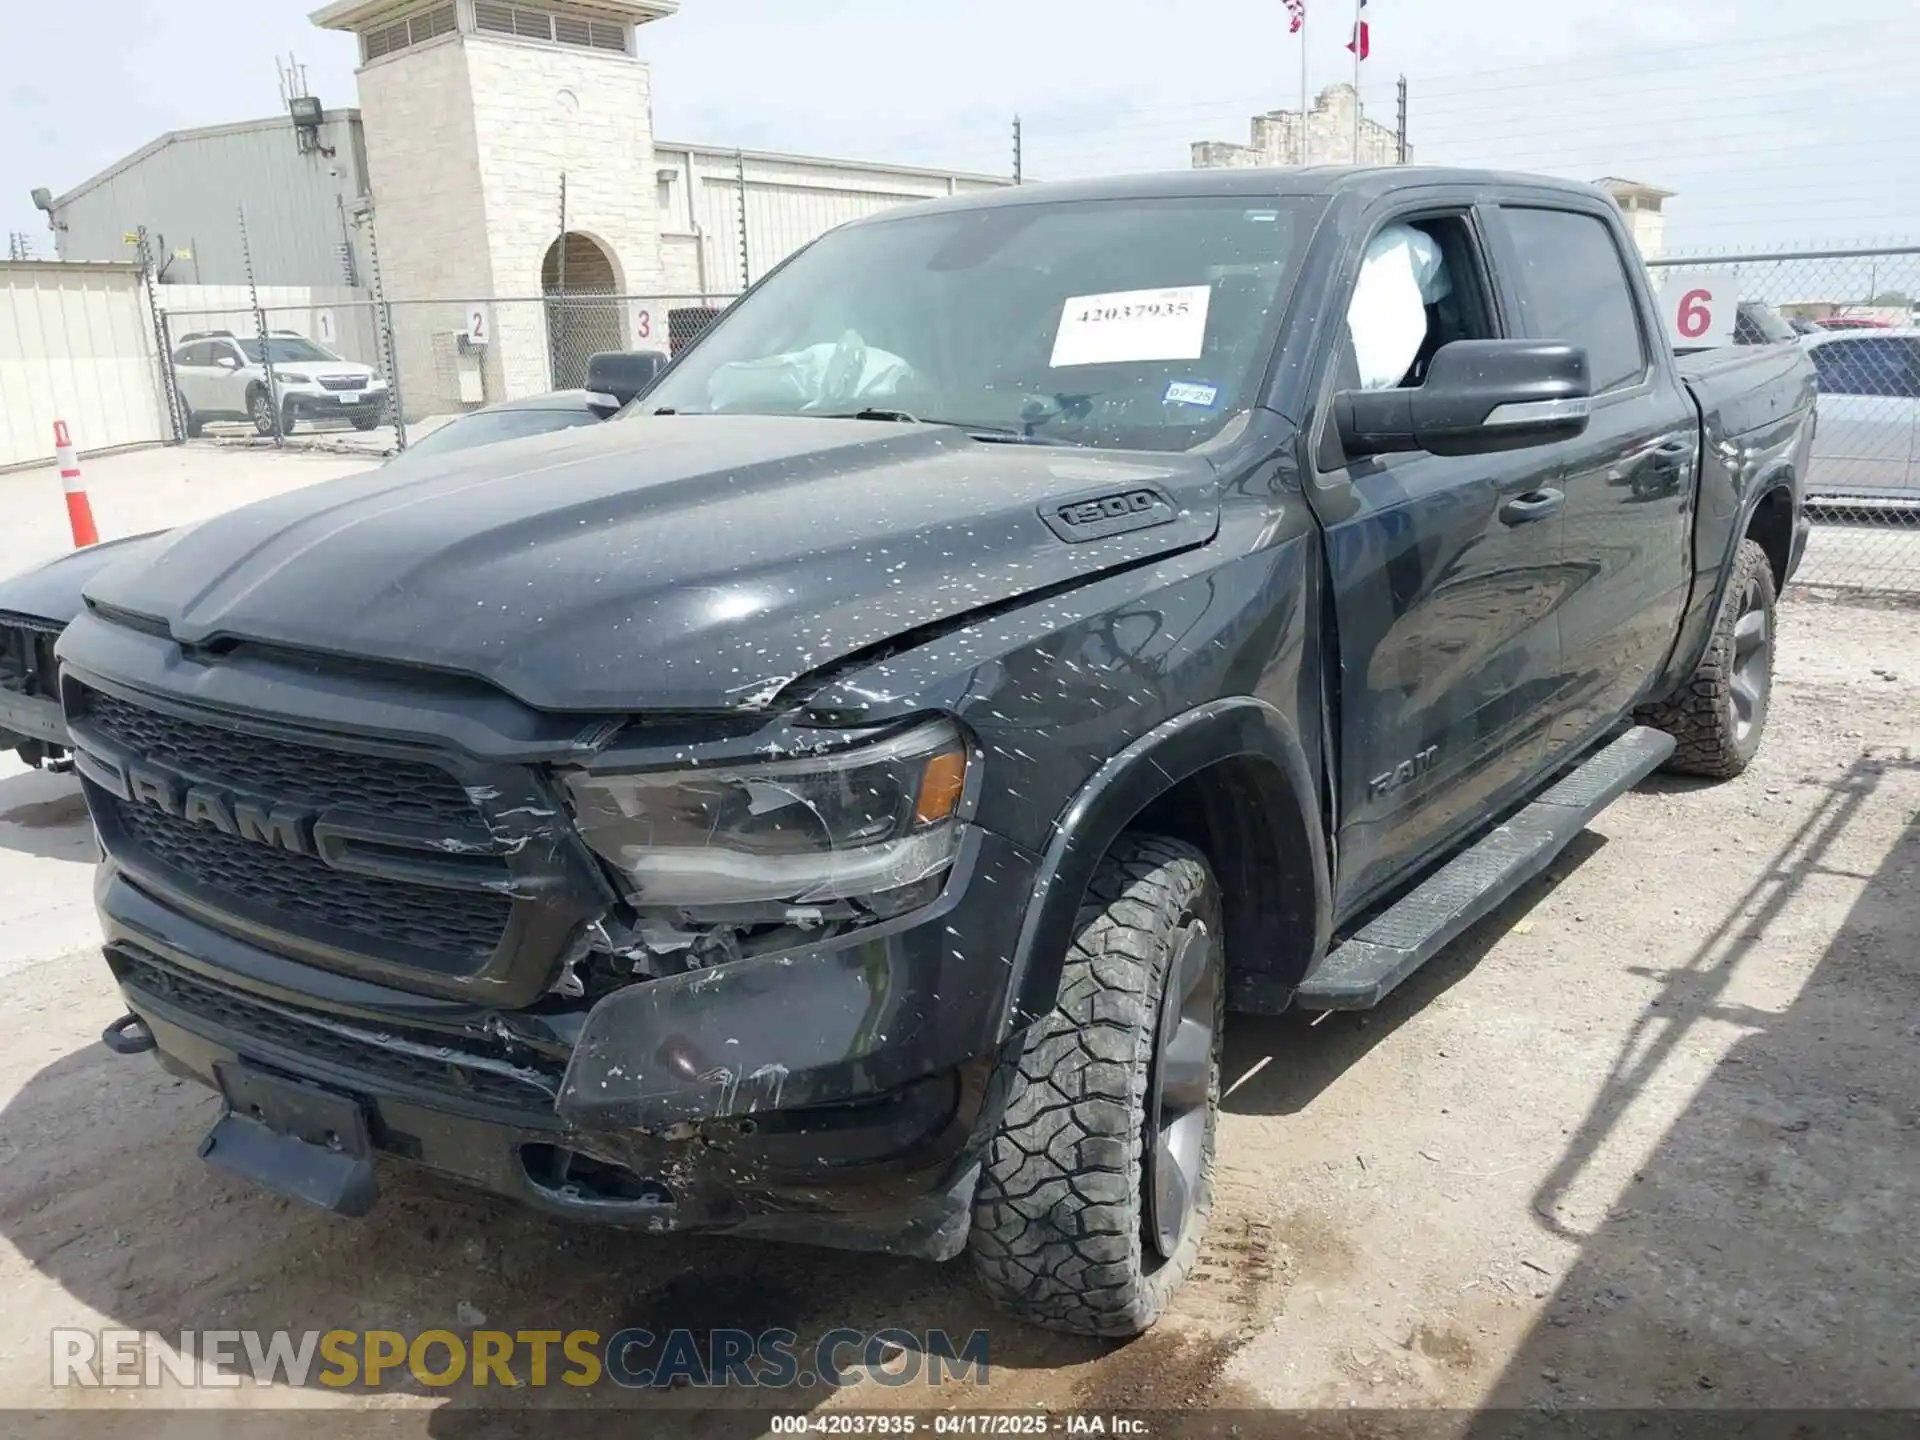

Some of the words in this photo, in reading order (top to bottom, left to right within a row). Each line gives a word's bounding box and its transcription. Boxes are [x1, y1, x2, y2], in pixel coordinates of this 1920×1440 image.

[321, 315, 329, 337] 1
[473, 312, 484, 337] 2
[638, 309, 650, 338] 3
[1075, 302, 1190, 322] 42037935
[1676, 288, 1713, 338] 6
[1059, 491, 1154, 526] 1500
[128, 764, 313, 854] RAM
